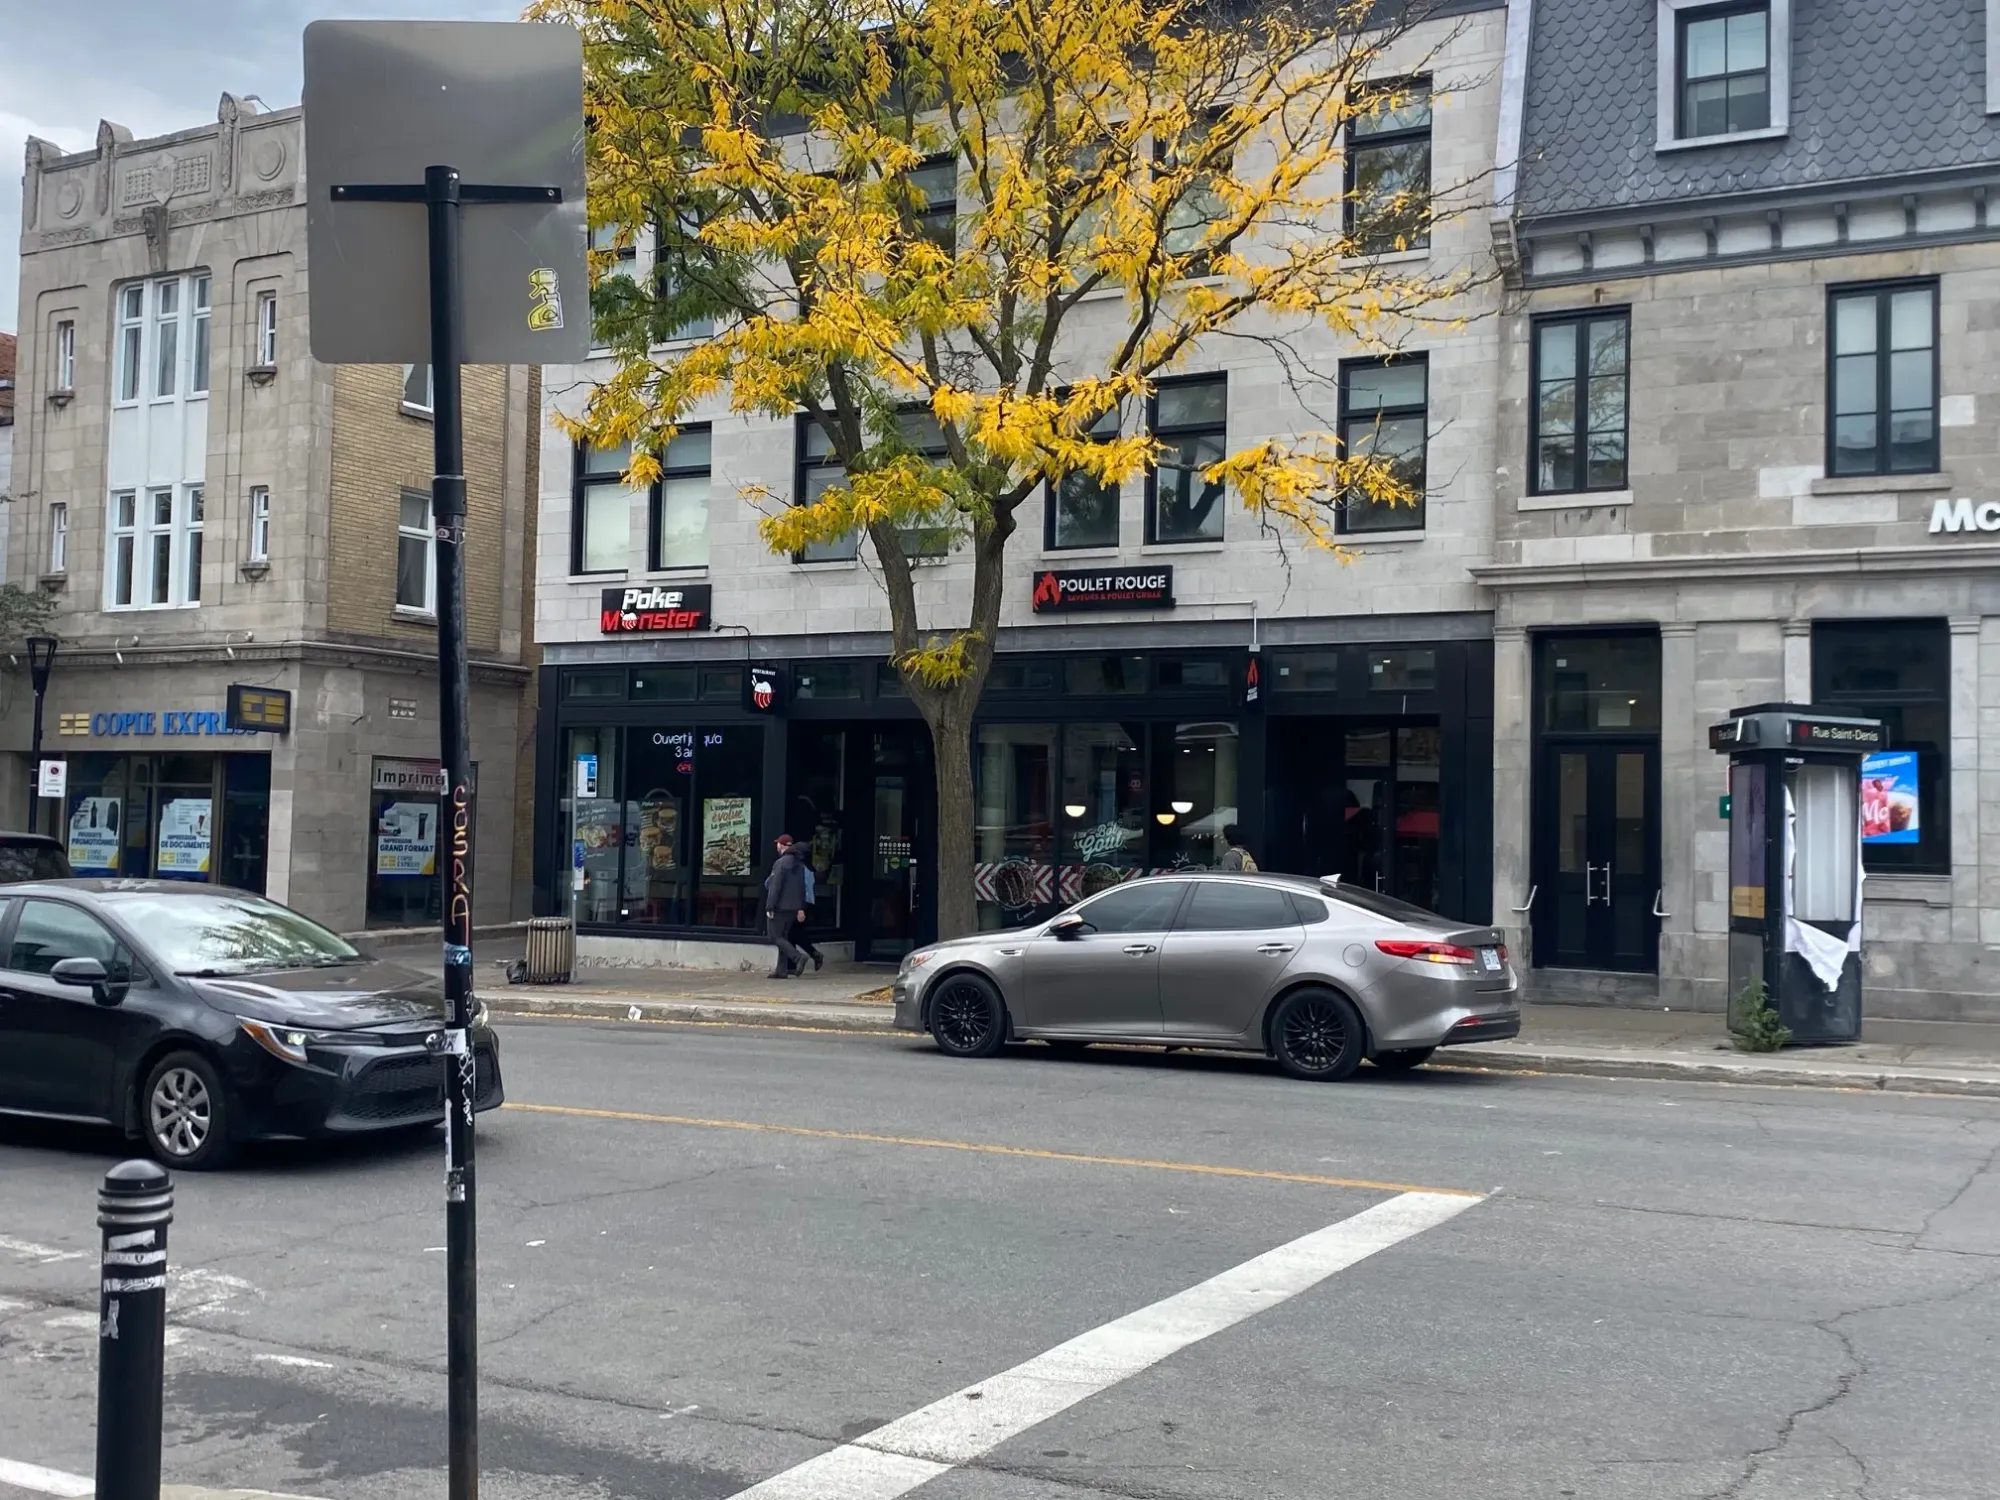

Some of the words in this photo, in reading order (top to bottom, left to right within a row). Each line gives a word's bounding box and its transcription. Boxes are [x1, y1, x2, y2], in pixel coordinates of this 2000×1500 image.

[1058, 576, 1112, 592] POULET
[1115, 574, 1166, 590] ROUGE
[621, 587, 683, 610] Poke
[1107, 592, 1134, 600] POULET
[91, 711, 157, 737] COPIE
[162, 711, 257, 737] EXPRE
[653, 732, 687, 745] Ouvert
[1812, 726, 1830, 738] Rue
[1831, 726, 1879, 742] Saint-Denis
[675, 746, 683, 758] 3
[169, 841, 210, 849] DOCUMENTS
[380, 844, 403, 852] GRAND
[404, 844, 434, 853] FORMAT
